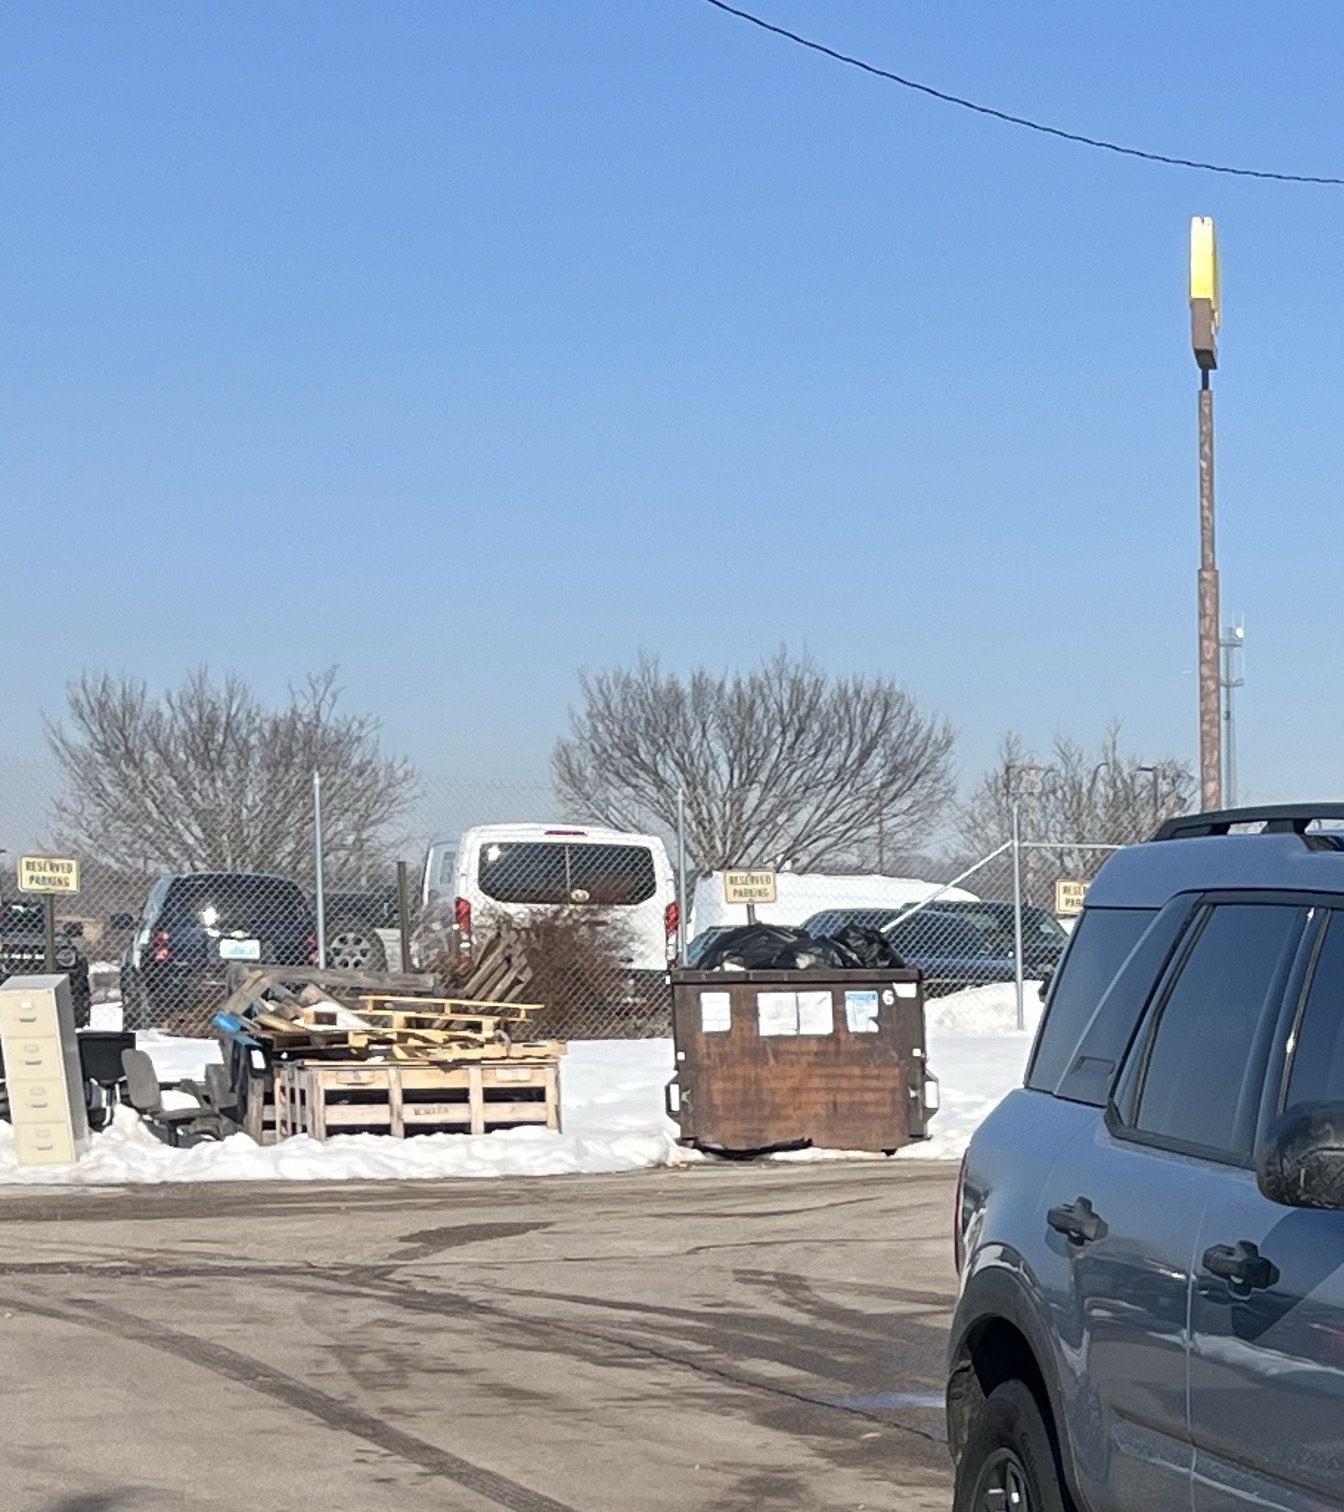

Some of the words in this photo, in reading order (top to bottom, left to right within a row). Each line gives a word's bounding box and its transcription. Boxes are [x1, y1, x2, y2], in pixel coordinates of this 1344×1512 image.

[26, 861, 73, 873] RESERVED
[29, 875, 70, 887] PARKING
[729, 875, 771, 885] RESERVED
[733, 888, 769, 897] PARKING
[882, 990, 894, 1005] 6
